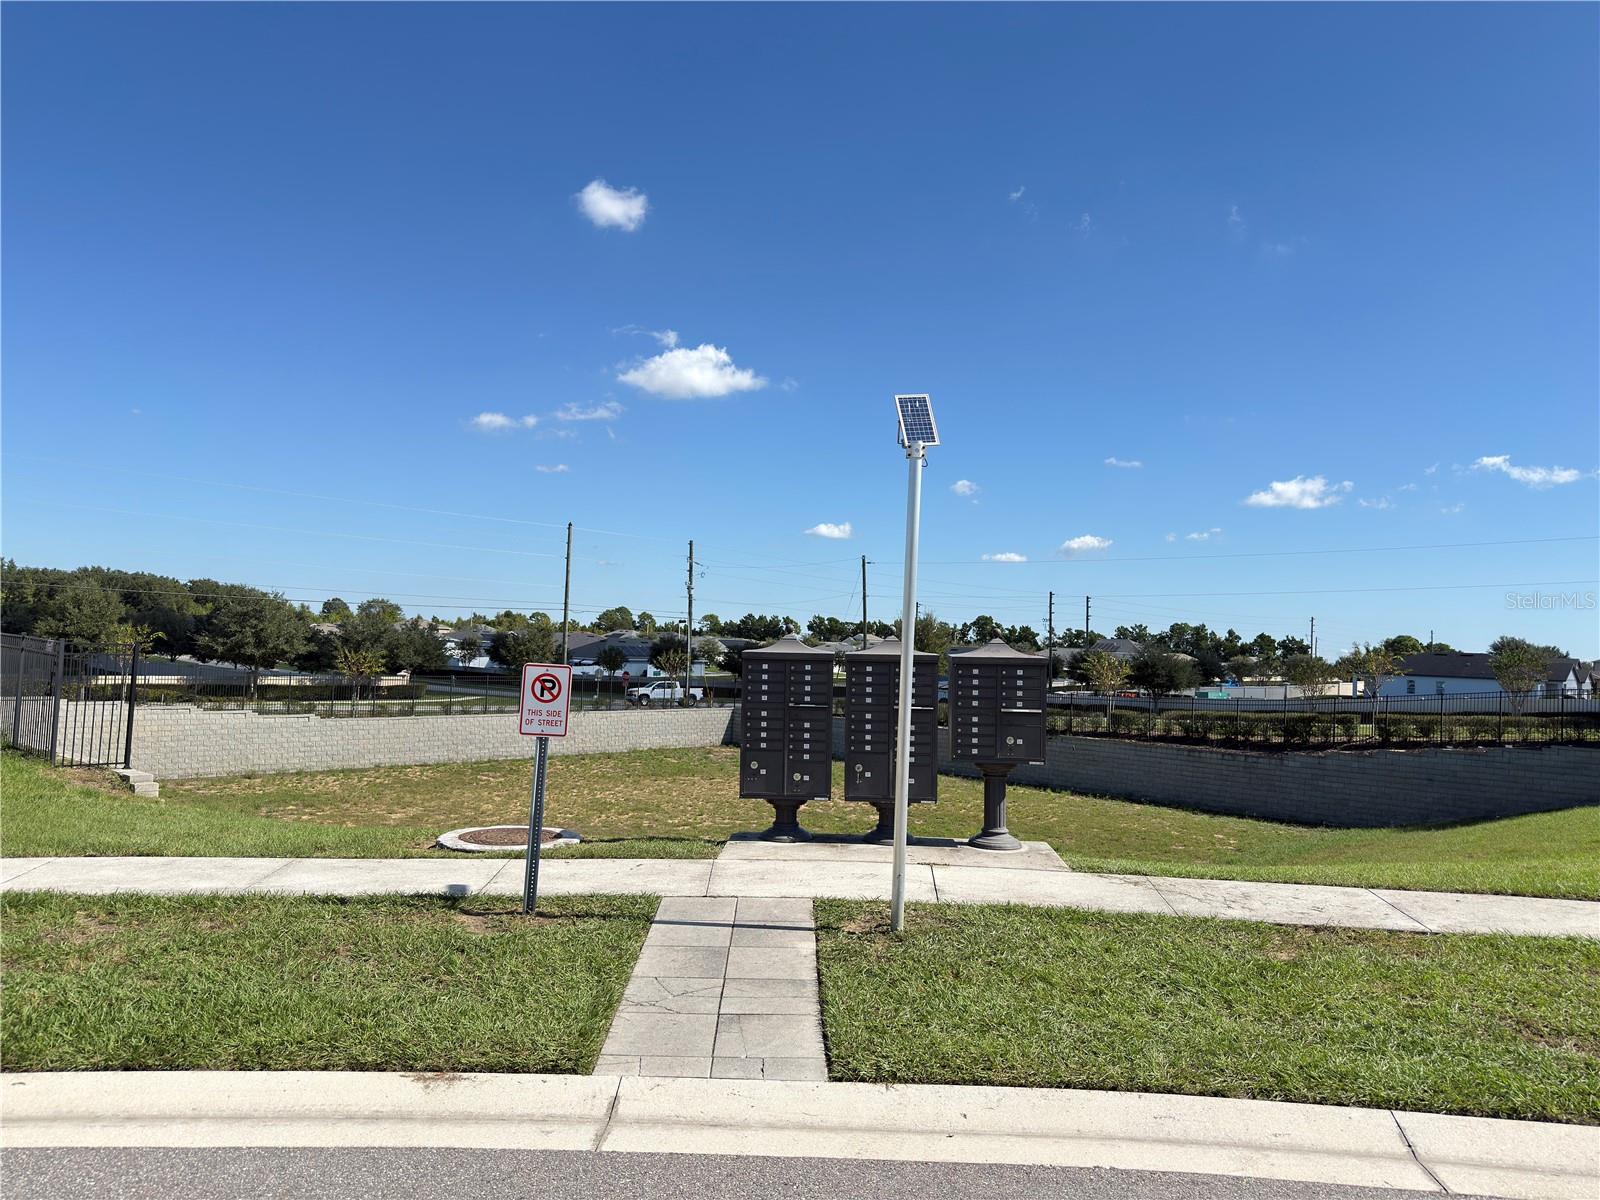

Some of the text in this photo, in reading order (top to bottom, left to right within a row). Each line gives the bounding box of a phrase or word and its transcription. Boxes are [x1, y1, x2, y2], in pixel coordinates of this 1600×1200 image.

[527, 709, 562, 718] THIS SIDE
[537, 719, 563, 727] STREET
